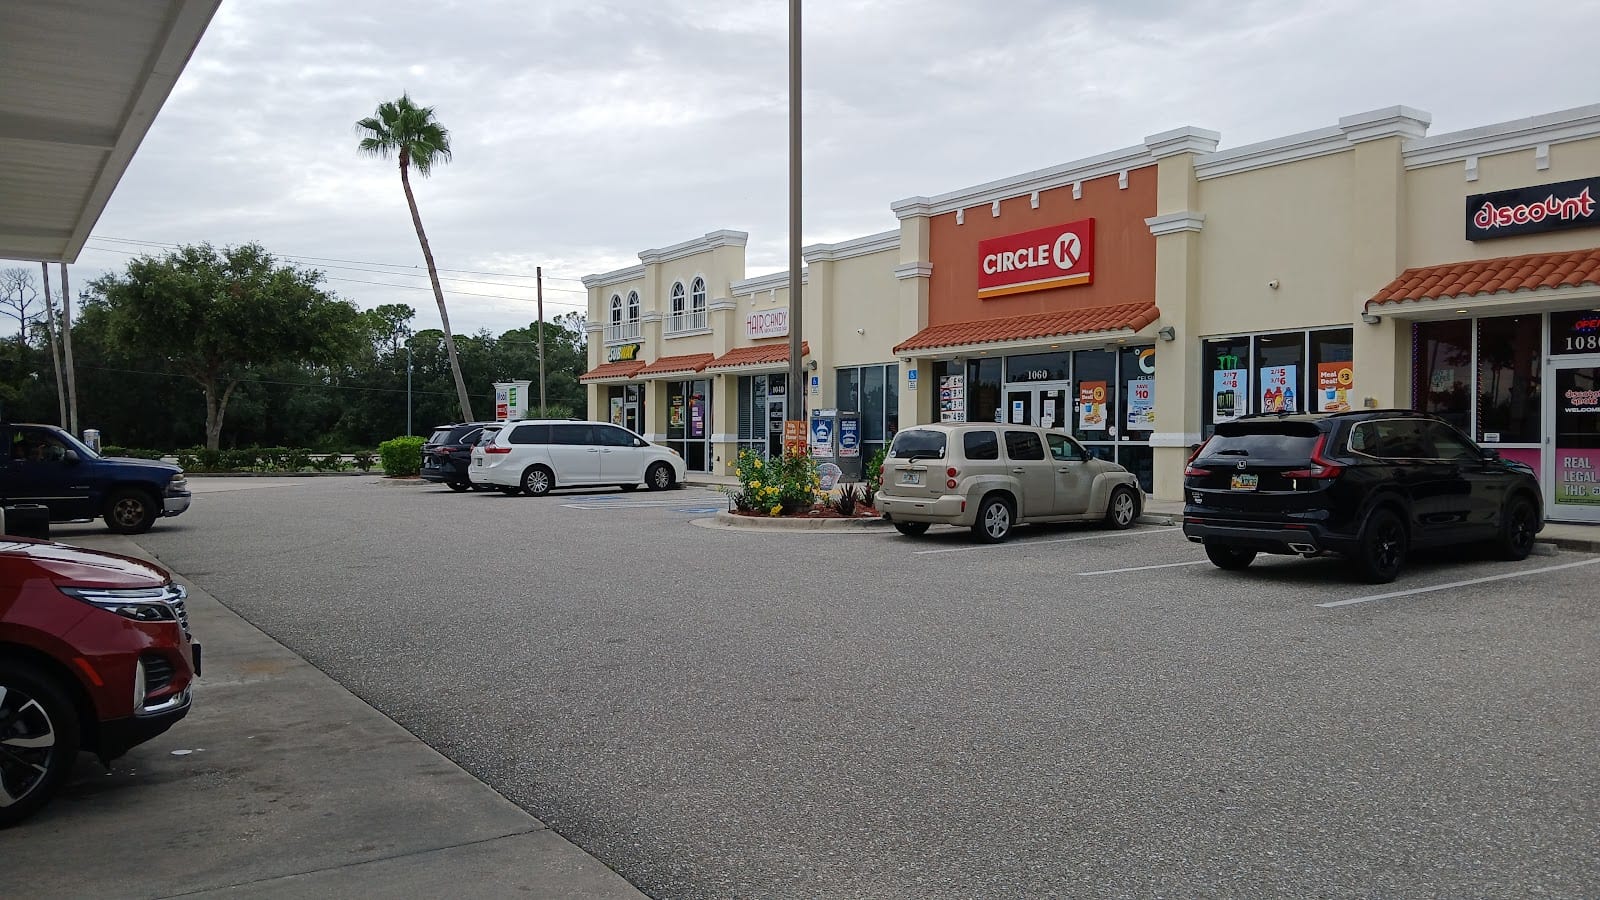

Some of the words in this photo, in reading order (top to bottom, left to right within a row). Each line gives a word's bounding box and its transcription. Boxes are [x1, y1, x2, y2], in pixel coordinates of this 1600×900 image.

[1474, 186, 1596, 230] discount
[983, 244, 1050, 275] CIRCLE
[1057, 236, 1080, 269] K
[746, 314, 764, 335] HAIR
[765, 311, 787, 328] CANDY
[1566, 336, 1600, 350] 108
[608, 345, 638, 362] SUBWAY
[1028, 370, 1048, 380] 1060
[1271, 368, 1286, 377] 2/$5
[1341, 373, 1350, 381] $3
[1136, 390, 1149, 399] $10
